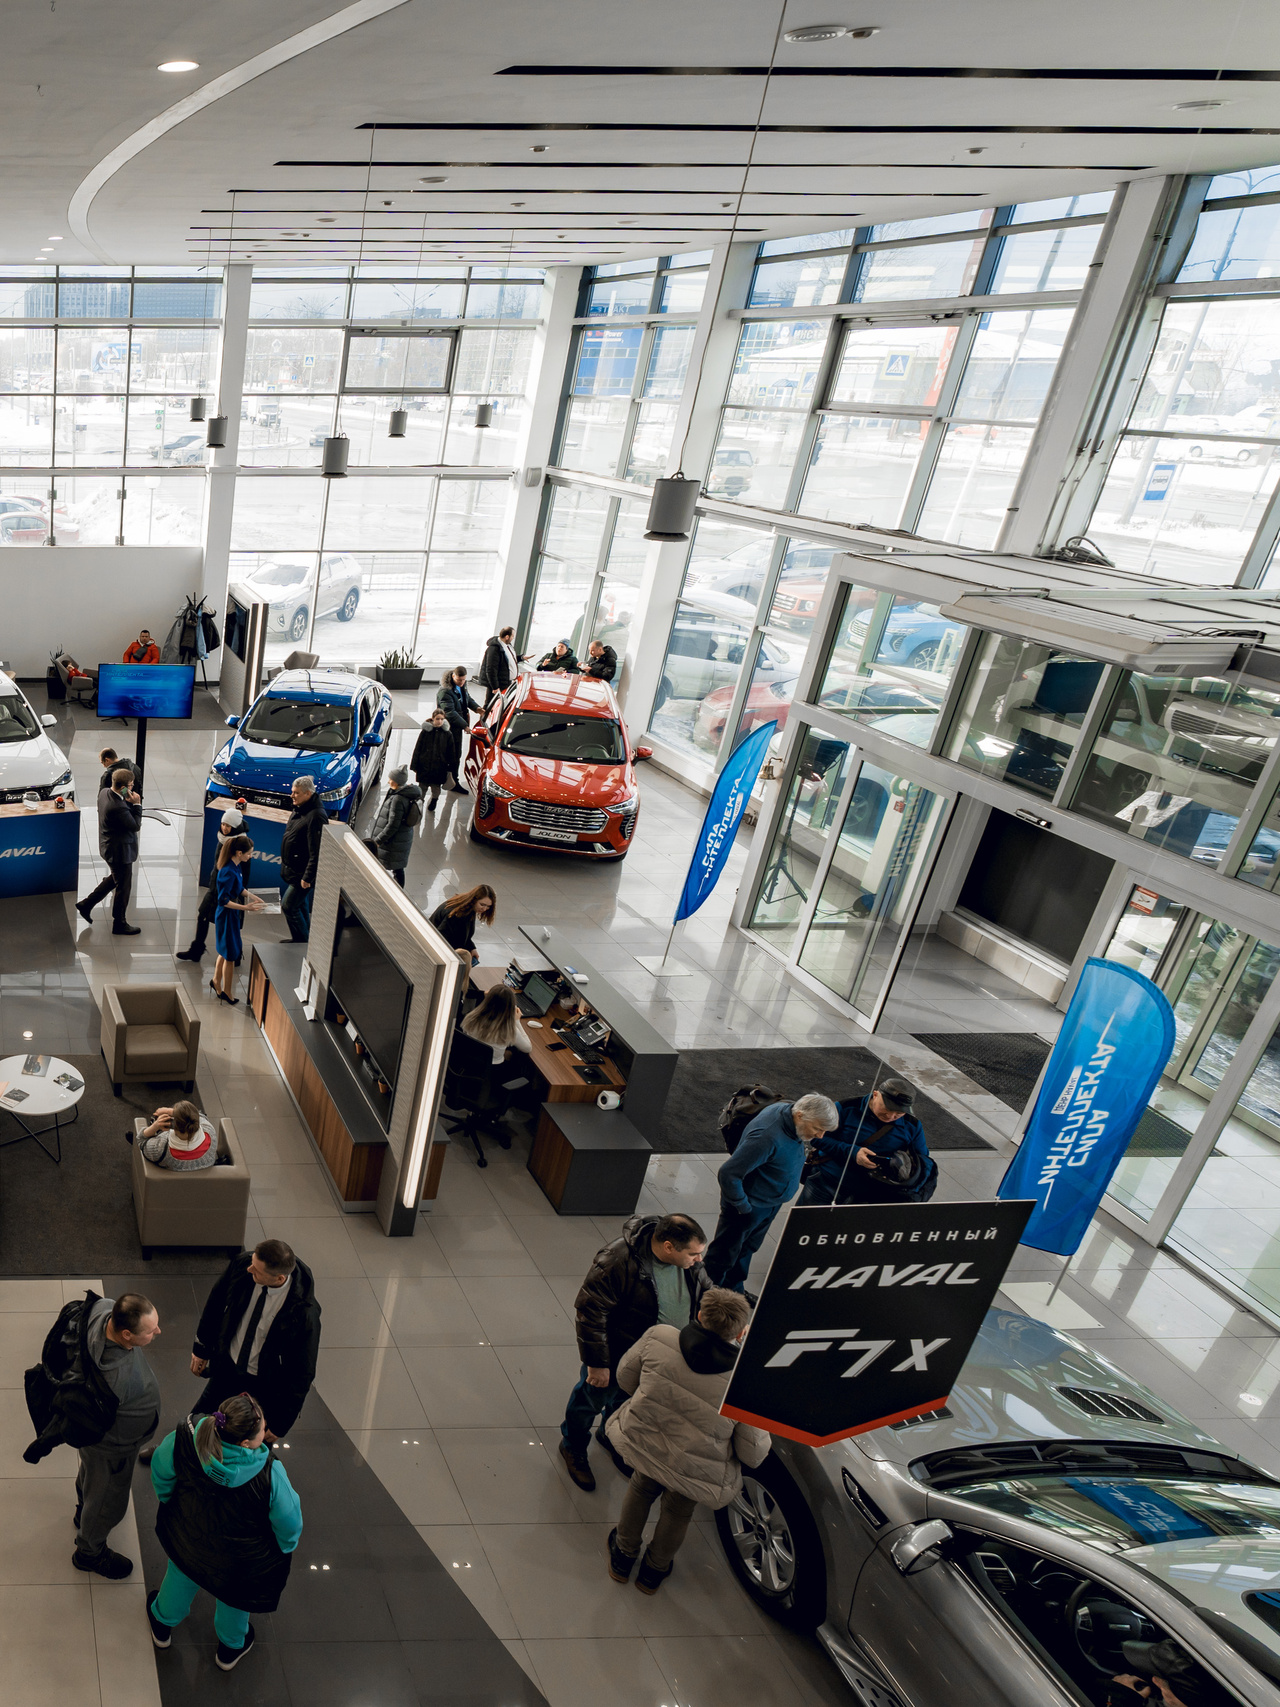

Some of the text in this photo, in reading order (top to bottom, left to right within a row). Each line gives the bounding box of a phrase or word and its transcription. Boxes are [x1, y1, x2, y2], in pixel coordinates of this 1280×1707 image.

[536, 830, 572, 840] JOLION
[702, 772, 745, 884] ИНТЕЛЛЕКТА
[702, 823, 721, 867] СИЛА
[250, 850, 282, 865] AVA
[798, 1226, 999, 1246] ОБНОВЛЕННЫЙ
[787, 1261, 981, 1290] HAVAL
